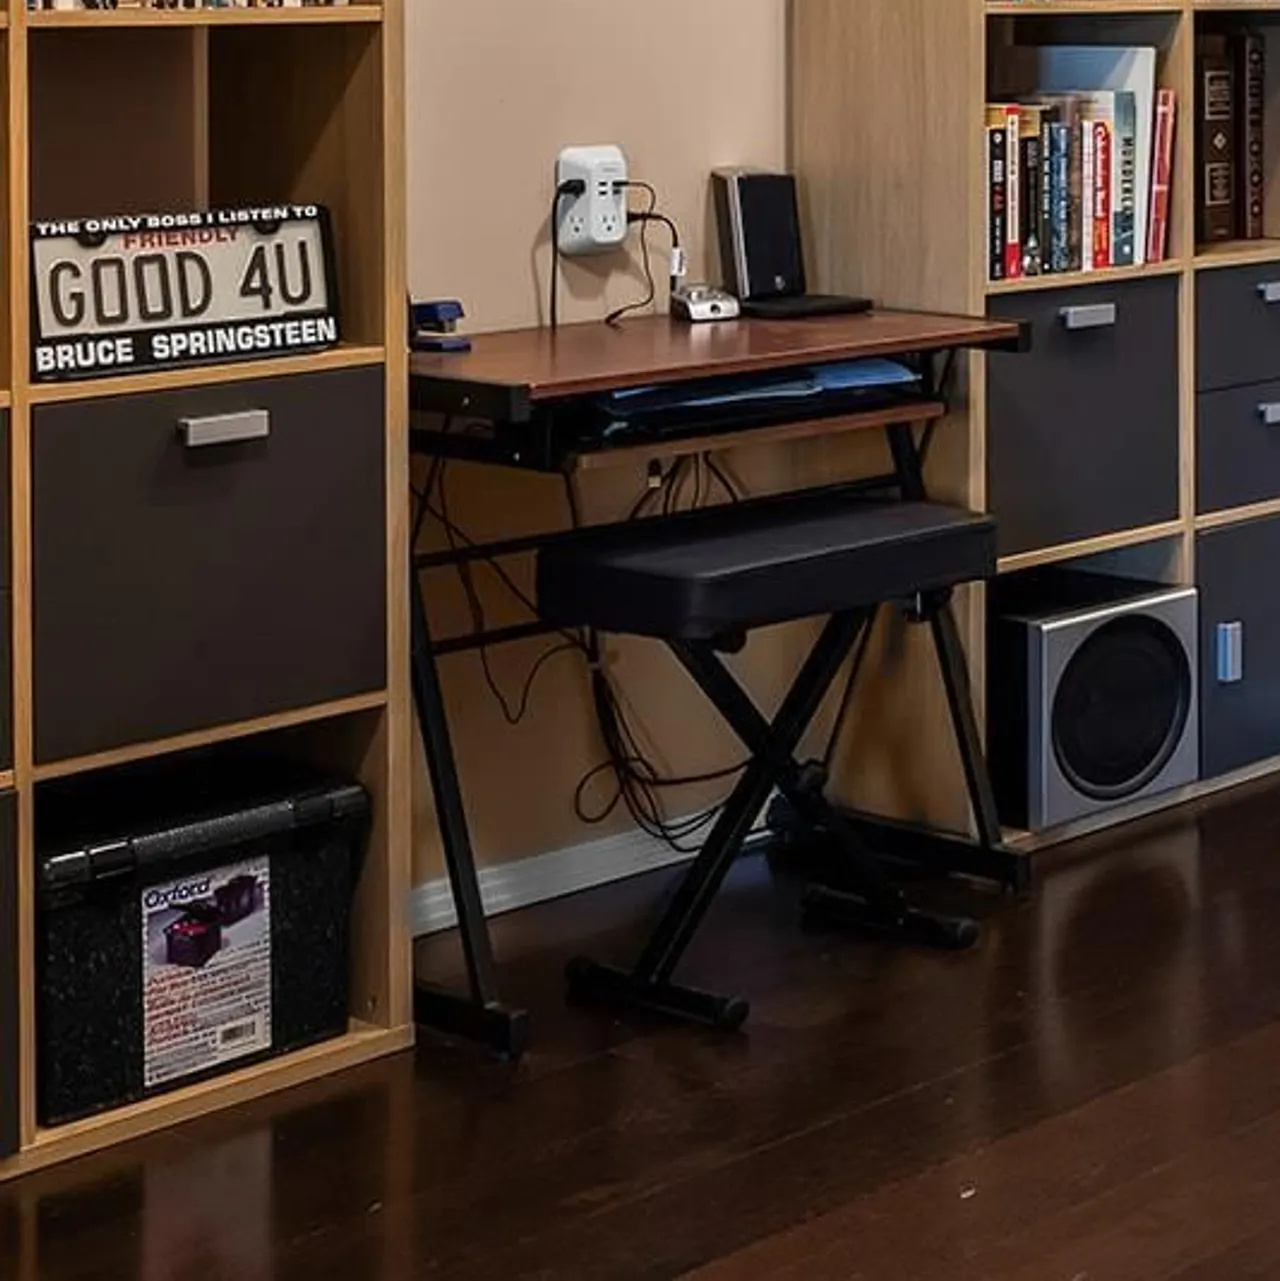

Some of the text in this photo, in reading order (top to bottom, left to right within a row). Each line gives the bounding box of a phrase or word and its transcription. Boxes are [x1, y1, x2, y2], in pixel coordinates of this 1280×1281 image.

[36, 221, 82, 237] THE
[85, 218, 141, 233] ONLY
[147, 214, 201, 228] BOSS
[218, 207, 290, 223] LISTEN
[292, 205, 319, 219] TO
[122, 226, 241, 250] FRIENDLY
[49, 239, 313, 328] GOOD 4U
[35, 317, 338, 373] BRUCE SPRINGSTEEN
